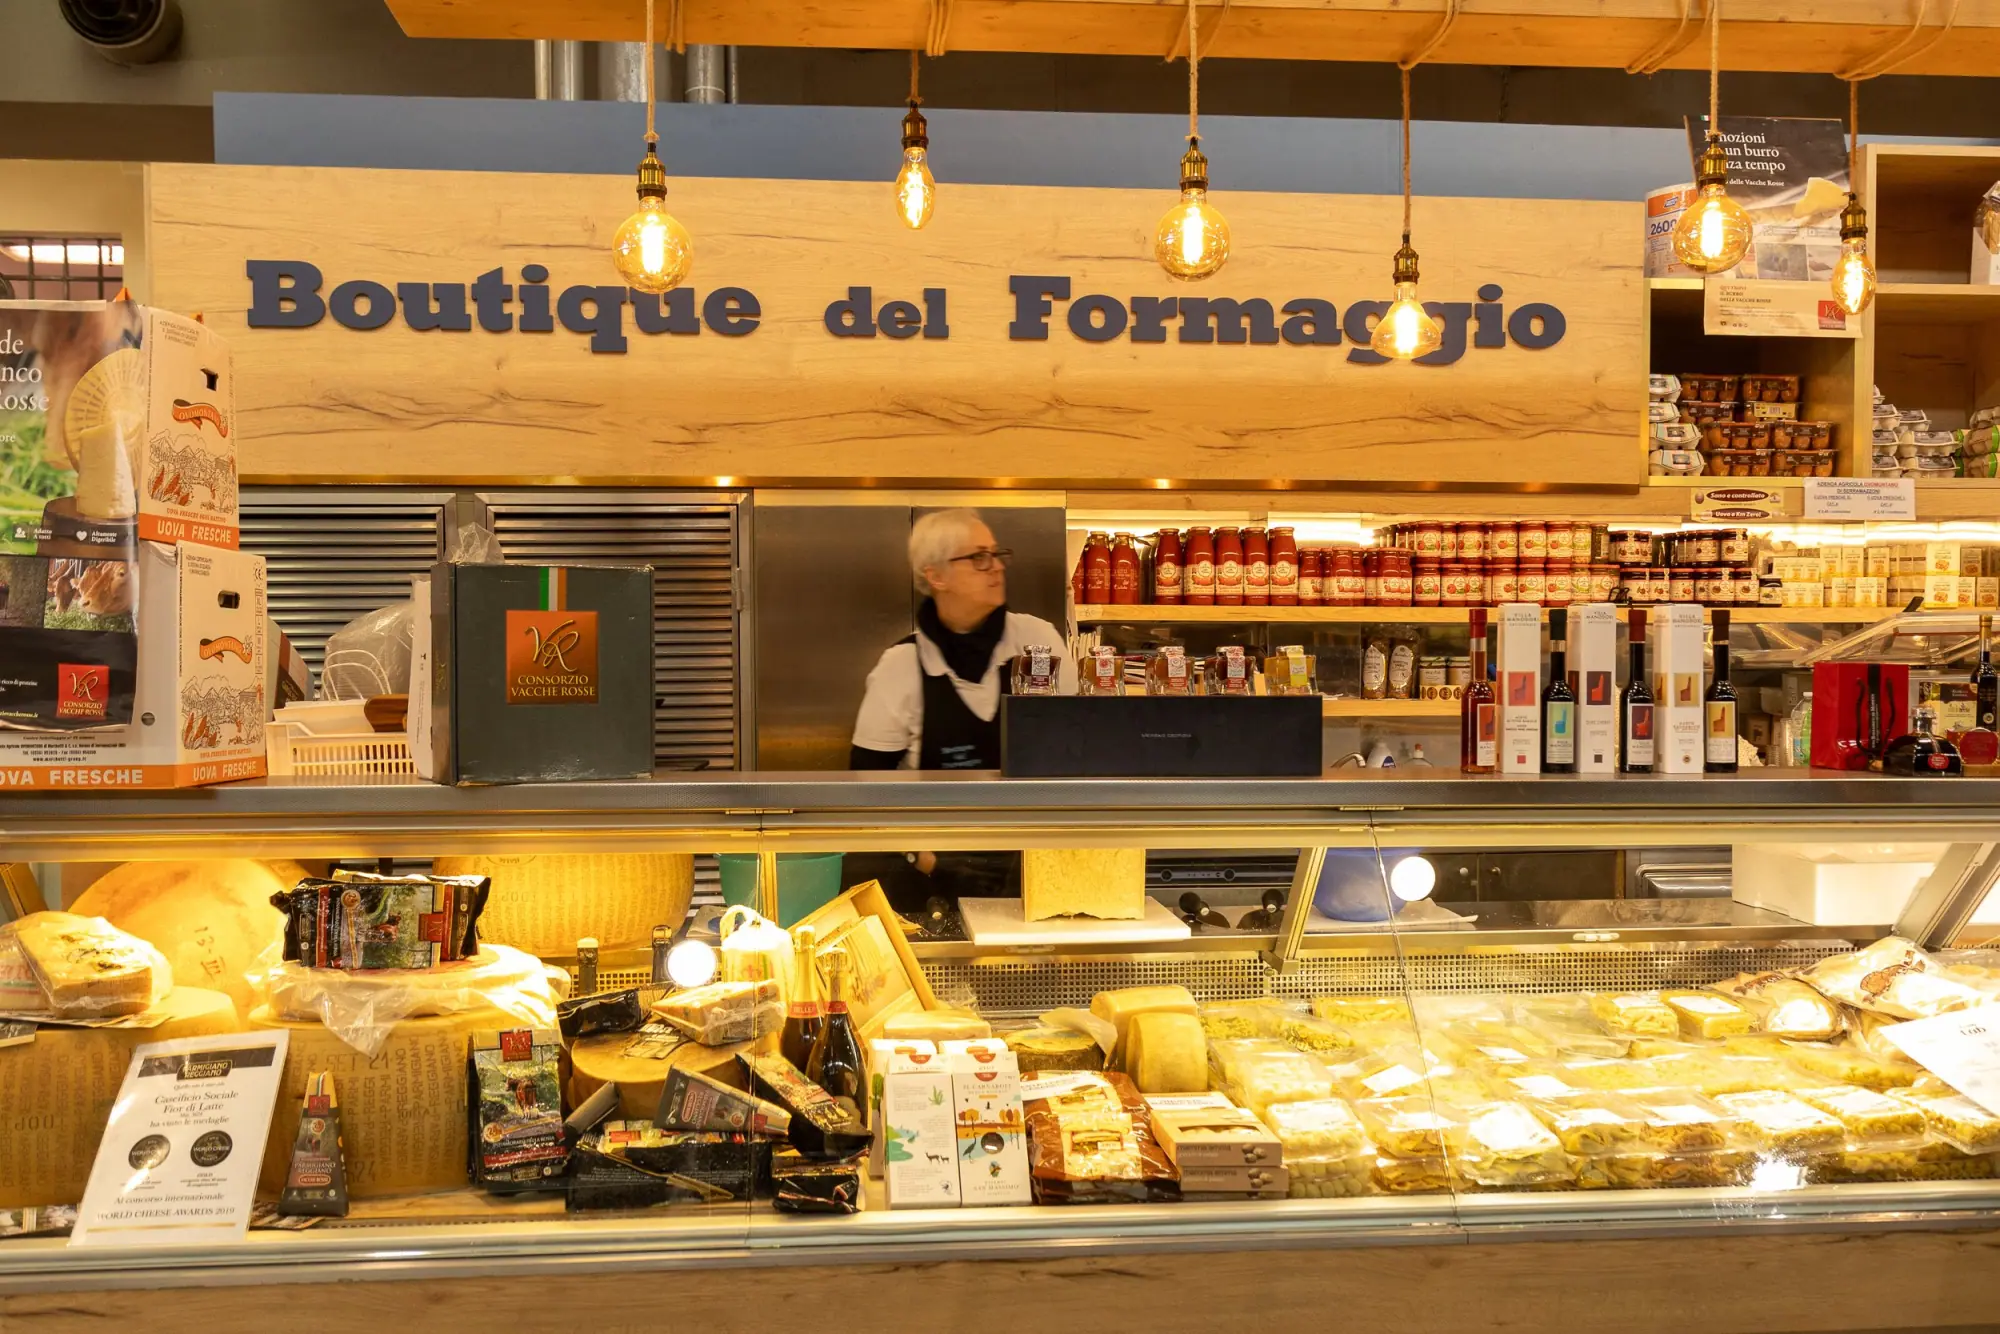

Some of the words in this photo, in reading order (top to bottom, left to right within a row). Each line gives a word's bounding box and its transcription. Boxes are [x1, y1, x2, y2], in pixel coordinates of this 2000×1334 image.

[1725, 147, 1742, 156] un
[1744, 144, 1780, 158] burro
[1745, 160, 1786, 175] tempo
[1745, 179, 1766, 187] Vacche
[246, 259, 762, 354] Boutique
[824, 286, 950, 340] del
[0, 328, 24, 355] de
[92, 530, 118, 538] Altamente
[157, 519, 185, 538] UOVA
[191, 525, 232, 543] FRESCHE
[91, 536, 117, 544] Digeribile
[517, 674, 589, 686] CONSORZIO
[511, 685, 559, 697] VACCHE
[560, 686, 596, 697] ROSSE
[63, 700, 103, 709] CONSORZIO
[60, 707, 85, 715] VACCHE
[85, 708, 105, 717] ROSSE
[49, 768, 143, 785] FRESCHE
[193, 765, 217, 782] UOVA
[222, 760, 257, 779] FRESCHE
[182, 1062, 228, 1073] PARMIGIANO
[184, 1069, 222, 1079] REGGIANO
[155, 1093, 201, 1105] Caseificio
[203, 1090, 239, 1100] Sociale
[163, 1104, 183, 1114] Fior
[186, 1103, 195, 1111] di
[199, 1102, 224, 1111] Latte
[150, 1120, 160, 1128] ha
[193, 1116, 229, 1126] medaglie
[115, 1196, 125, 1205] Al
[126, 1195, 163, 1204] concorso
[164, 1192, 225, 1203] internazionale
[97, 1210, 133, 1221] WORLD
[134, 1208, 172, 1219] CHEESE
[172, 1207, 214, 1217] AWARDS
[215, 1206, 236, 1216] 2019
